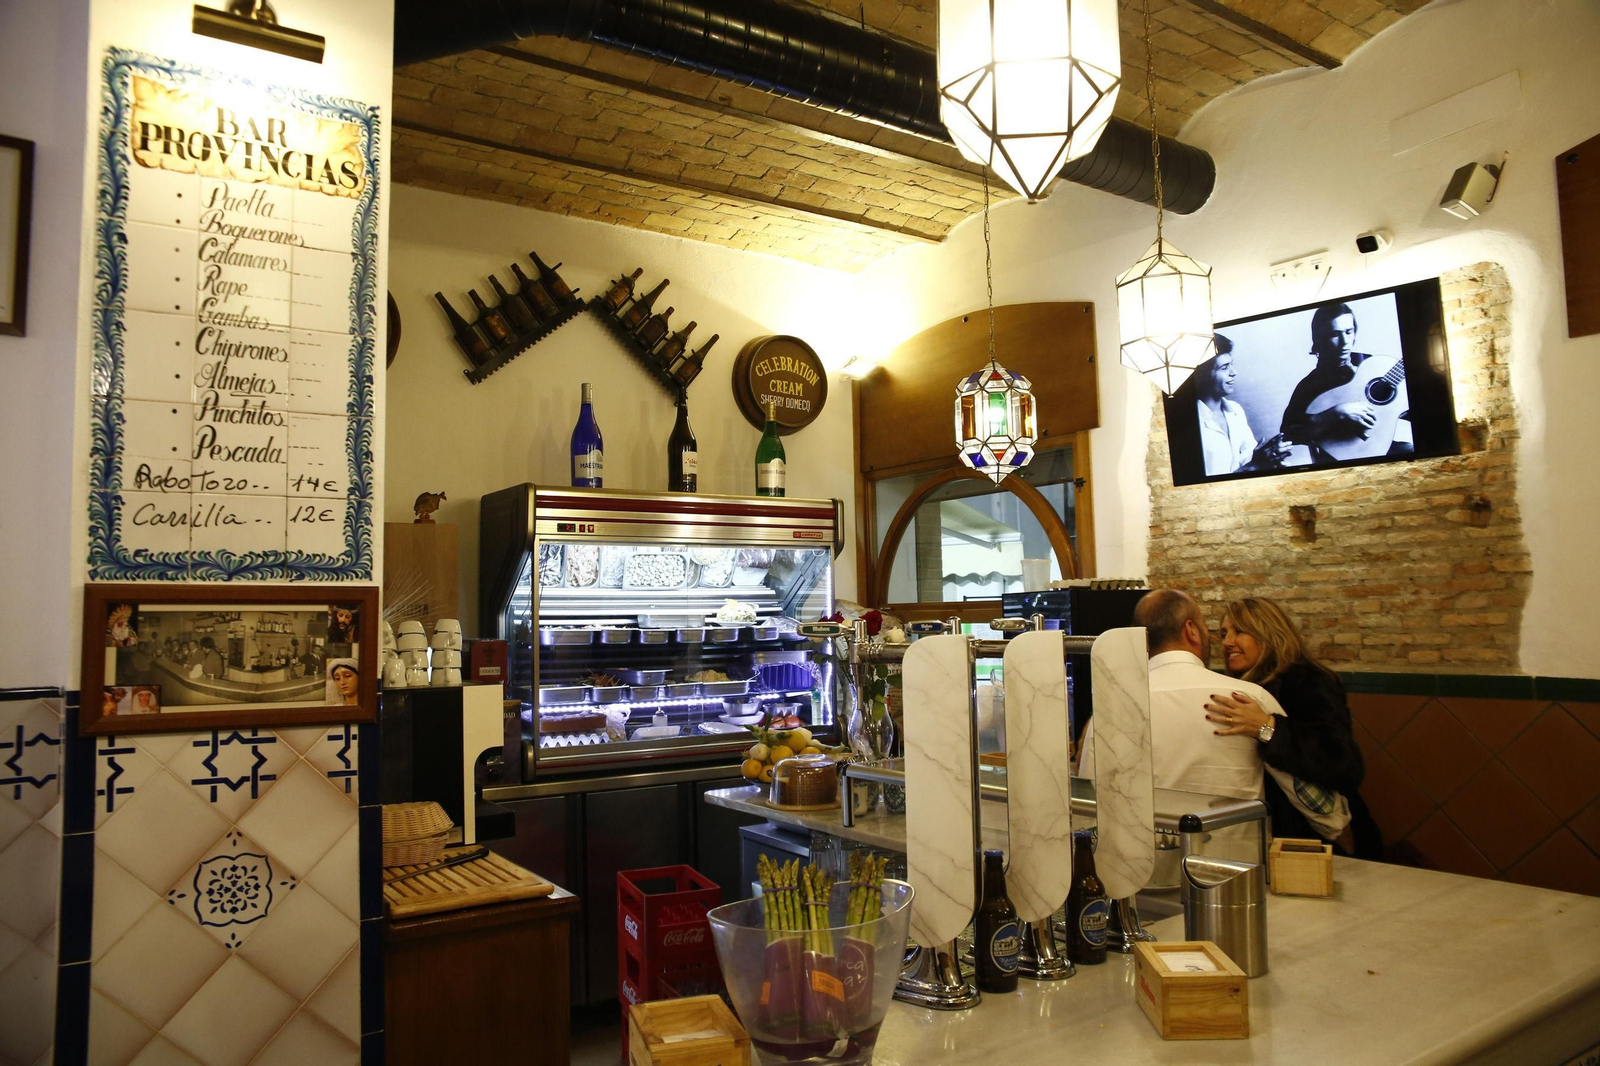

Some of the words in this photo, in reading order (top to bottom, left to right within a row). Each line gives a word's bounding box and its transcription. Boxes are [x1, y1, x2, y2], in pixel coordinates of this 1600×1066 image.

[214, 106, 288, 148] BAR
[139, 121, 360, 189] PROVINCIAS
[201, 180, 275, 219] Paella
[199, 208, 305, 249] Boquerones
[198, 237, 289, 272] Calamares
[197, 264, 248, 304] Rape
[197, 297, 270, 331] Gambas
[194, 326, 289, 365] Chipirones
[194, 360, 276, 398] Almejas
[755, 355, 820, 387] CELEBRATION
[769, 379, 804, 397] CREAM
[194, 389, 284, 427] Pinchitos
[785, 397, 811, 413] DOMECQ
[192, 424, 282, 464] Pescada
[291, 474, 339, 493] 14€
[289, 505, 336, 524] 12€
